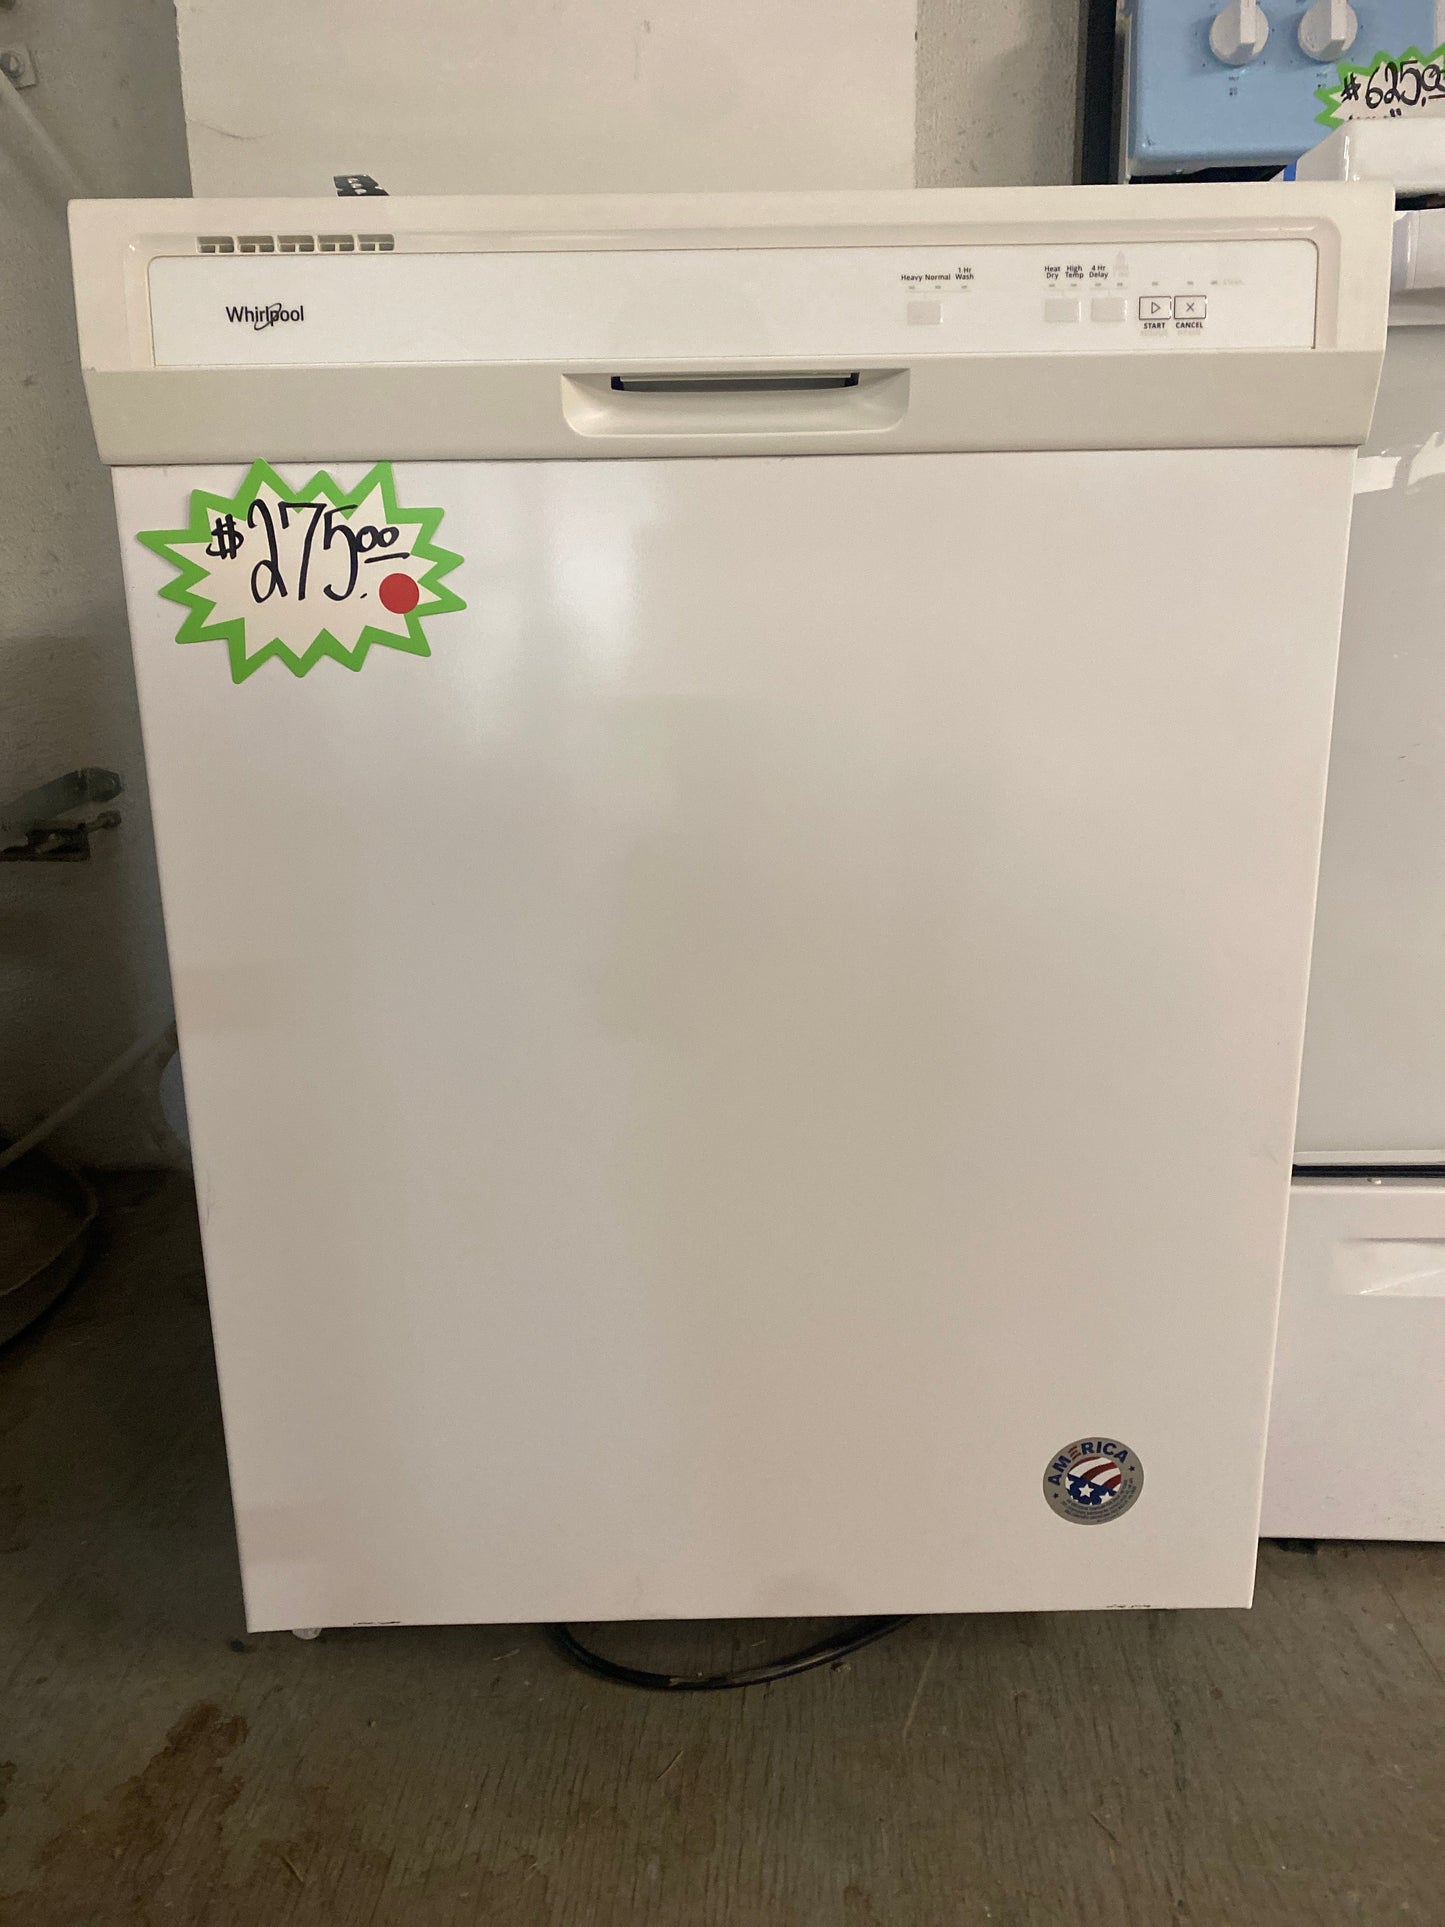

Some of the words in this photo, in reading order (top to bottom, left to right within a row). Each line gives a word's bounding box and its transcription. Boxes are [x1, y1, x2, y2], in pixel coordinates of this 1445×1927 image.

[1066, 264, 1083, 273] High
[901, 274, 923, 282] Heavy
[924, 273, 951, 281] Normal
[1046, 271, 1059, 280] Dry
[1065, 271, 1084, 279] Temp
[1088, 271, 1109, 280] Delay
[225, 302, 305, 331] Whirlpool
[1143, 322, 1166, 330] START
[1175, 321, 1204, 329] CANCEL
[1047, 1441, 1129, 1487] AMERICA
